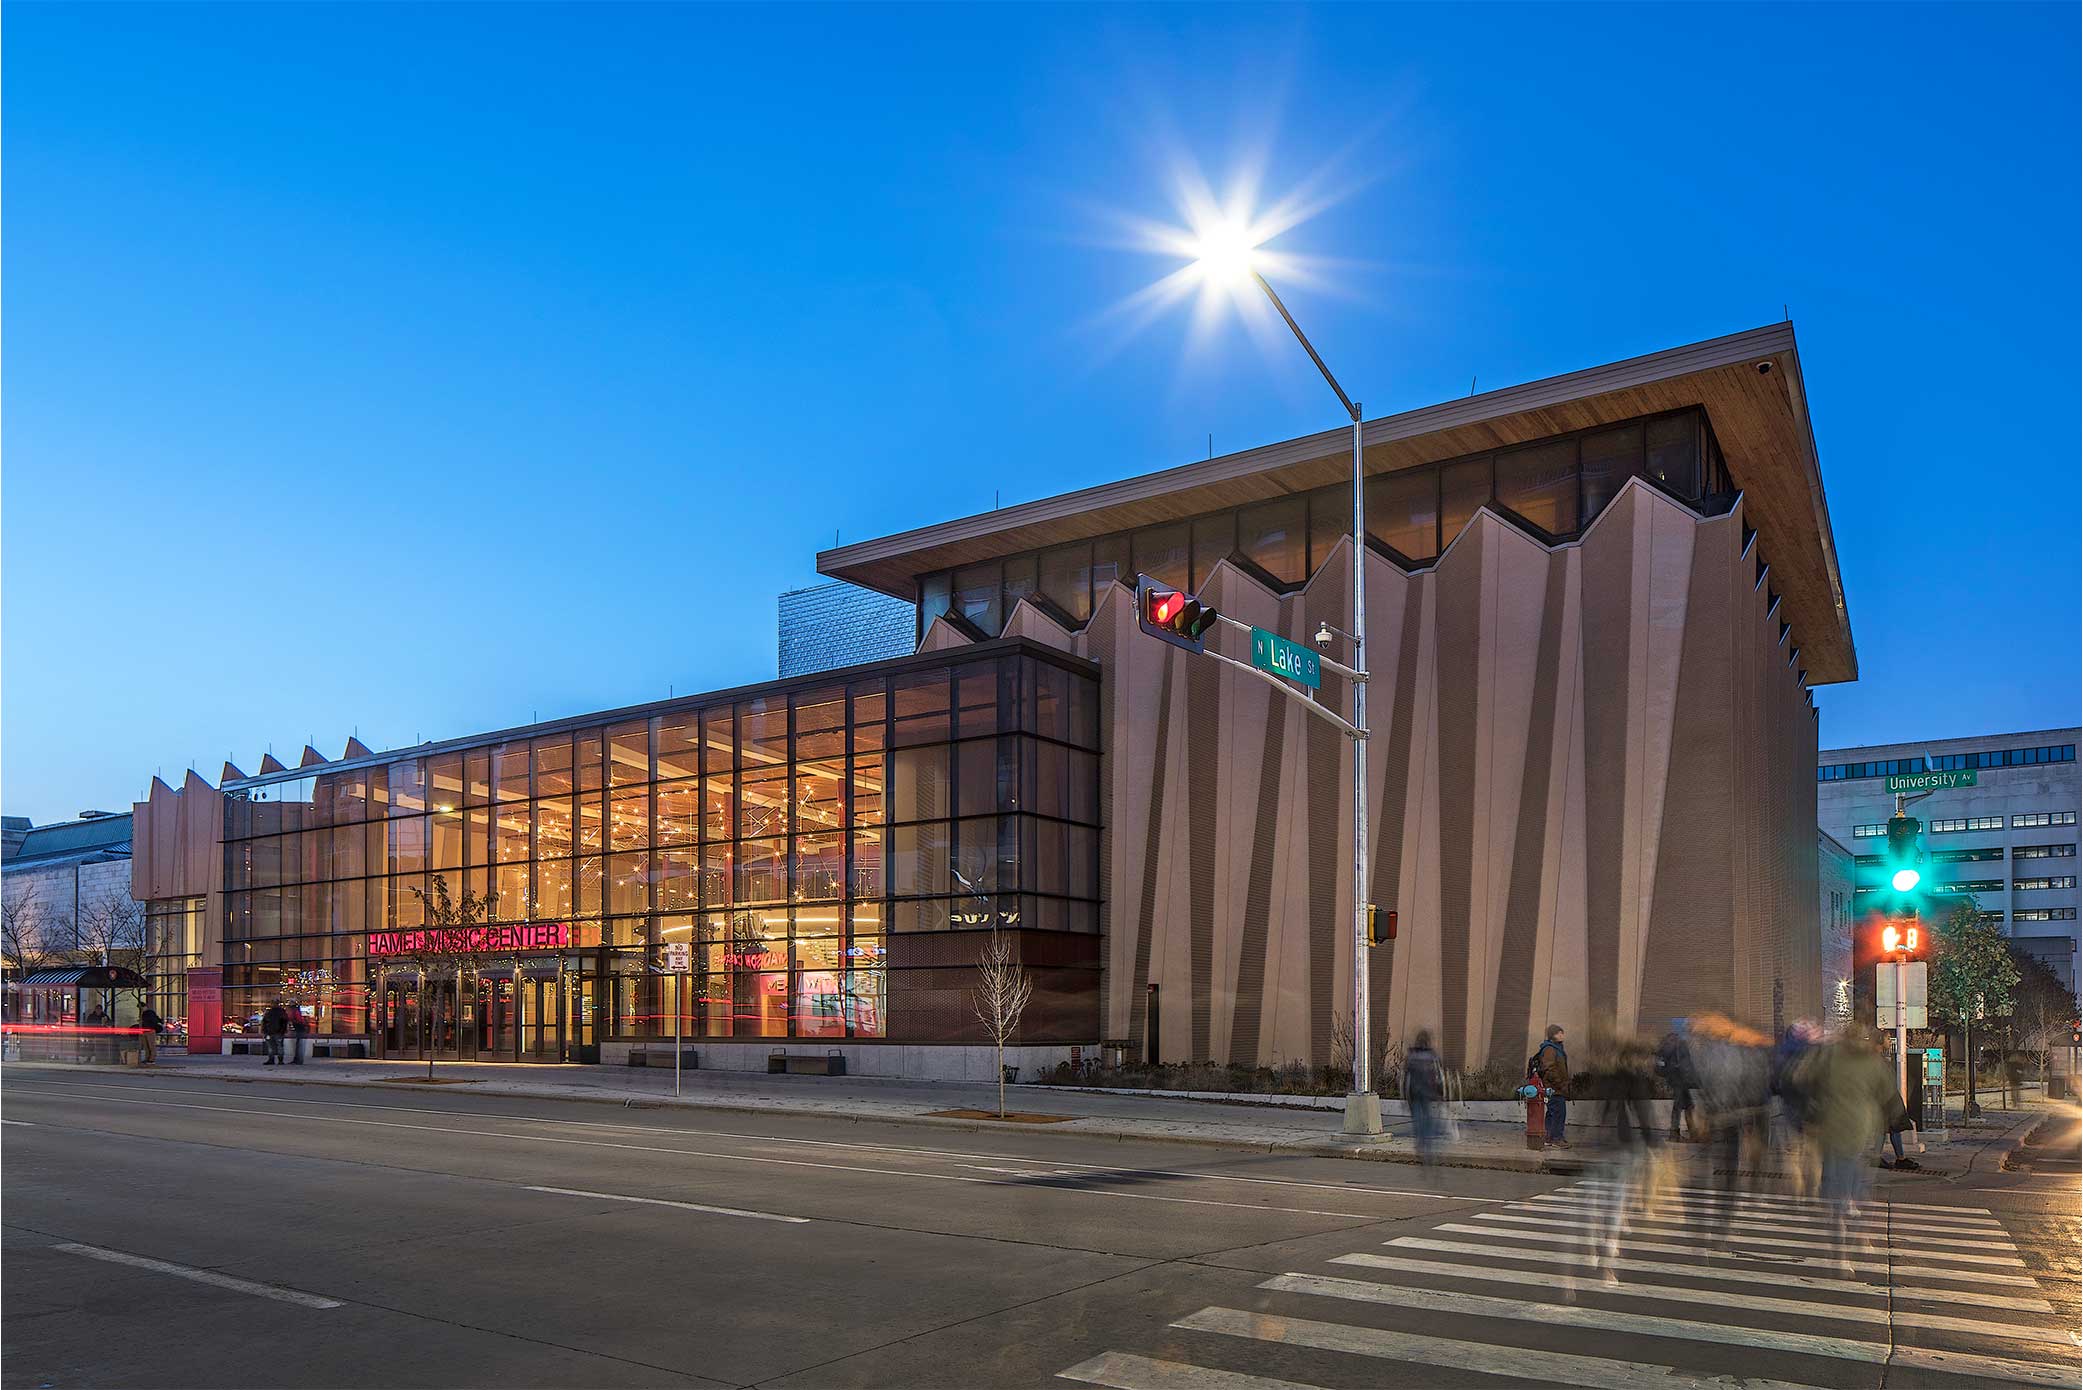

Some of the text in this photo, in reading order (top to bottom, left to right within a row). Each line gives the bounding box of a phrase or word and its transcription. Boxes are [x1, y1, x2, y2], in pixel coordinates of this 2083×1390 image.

[1257, 639, 1315, 676] N Lake St
[1890, 773, 1957, 790] University
[368, 924, 560, 953] HAMEL MUSIC CENTER
